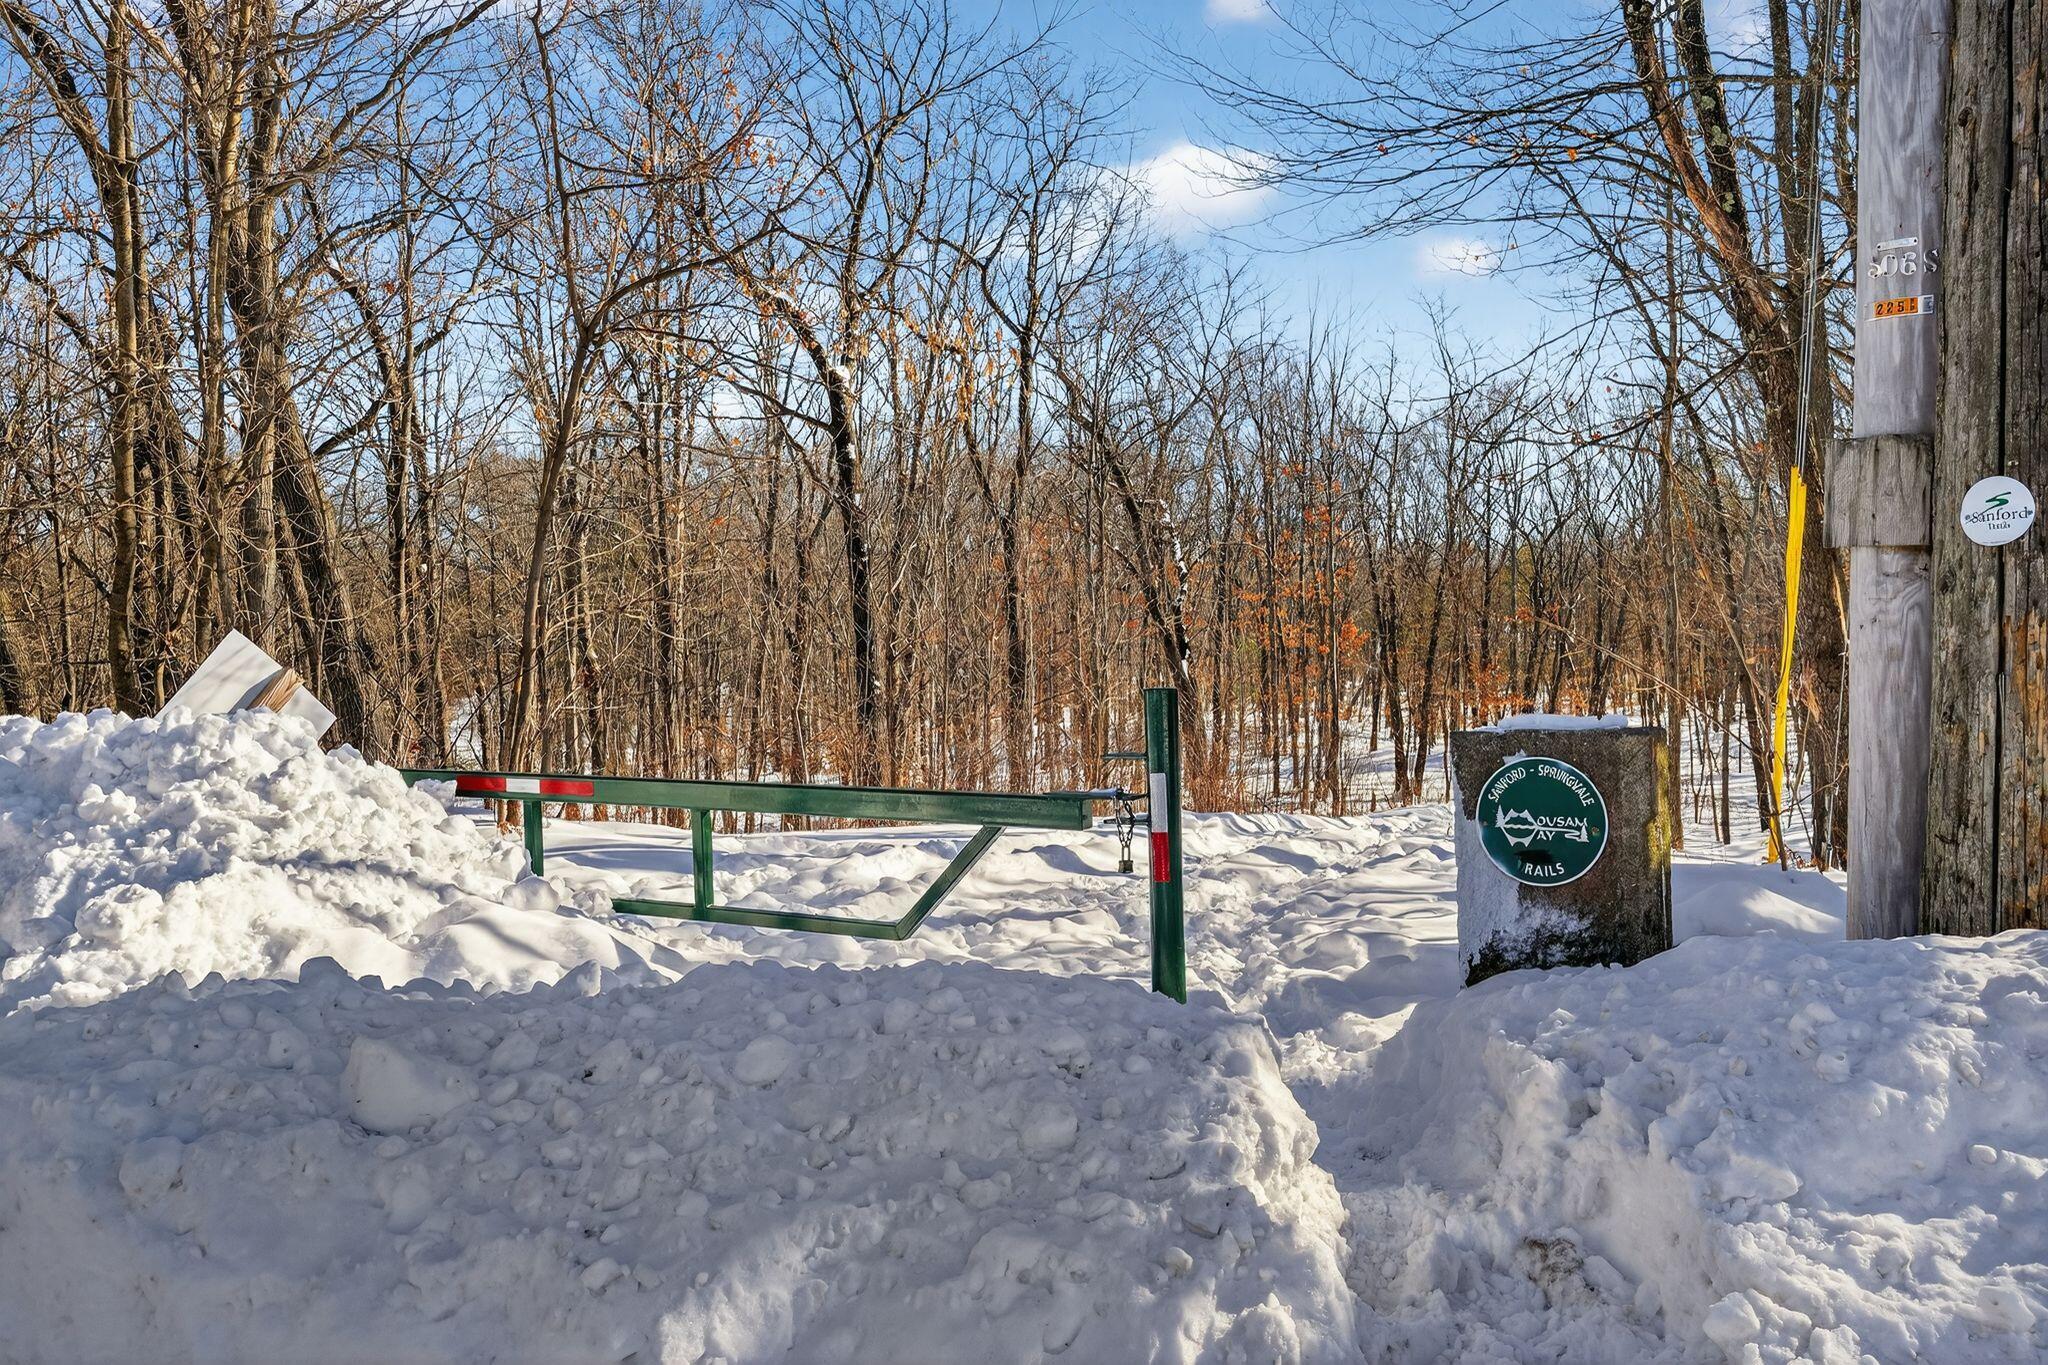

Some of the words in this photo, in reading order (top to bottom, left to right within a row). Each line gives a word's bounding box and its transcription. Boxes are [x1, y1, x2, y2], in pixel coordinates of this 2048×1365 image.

[1970, 507, 2028, 524] Sanford
[1488, 767, 1526, 803] SANFORD
[1517, 860, 1565, 877] RAILS
